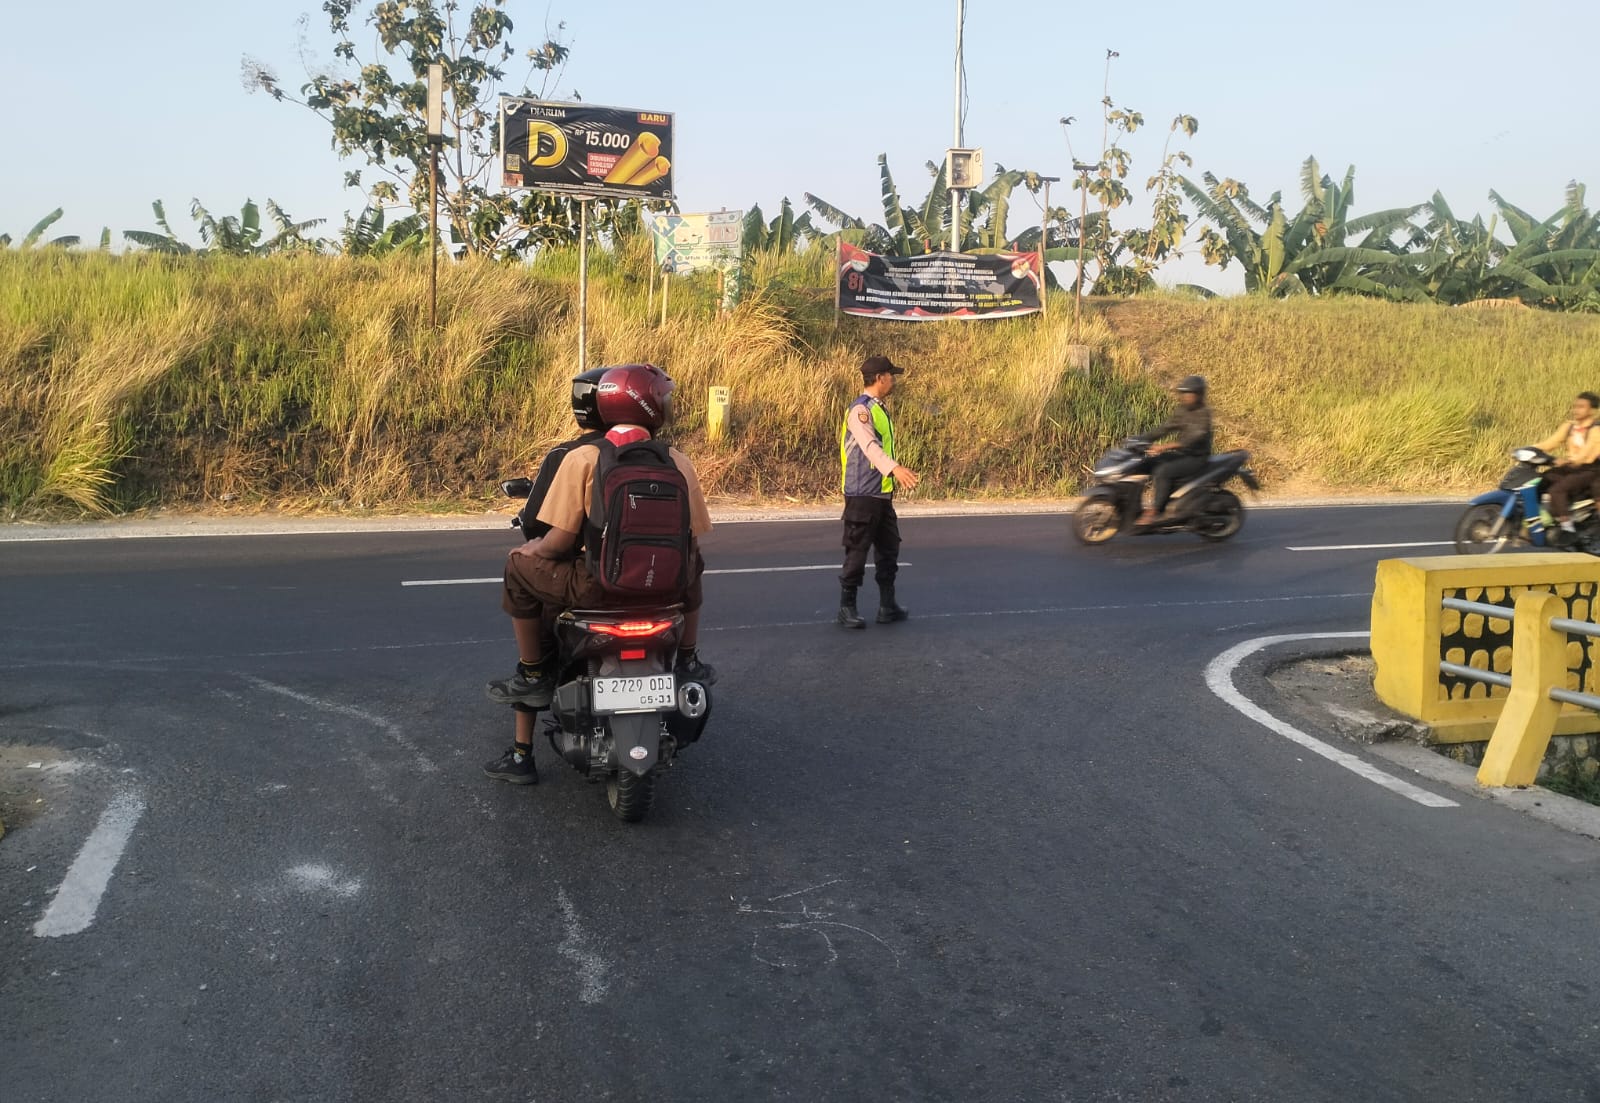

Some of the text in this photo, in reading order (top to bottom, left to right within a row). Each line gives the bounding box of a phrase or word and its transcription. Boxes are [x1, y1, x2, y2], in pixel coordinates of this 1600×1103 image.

[530, 107, 566, 118] DJARUM
[640, 112, 666, 122] BARU
[526, 118, 569, 169] D
[585, 131, 630, 149] 15.000
[848, 272, 864, 292] 81
[597, 680, 604, 694] S
[612, 679, 643, 693] 2729
